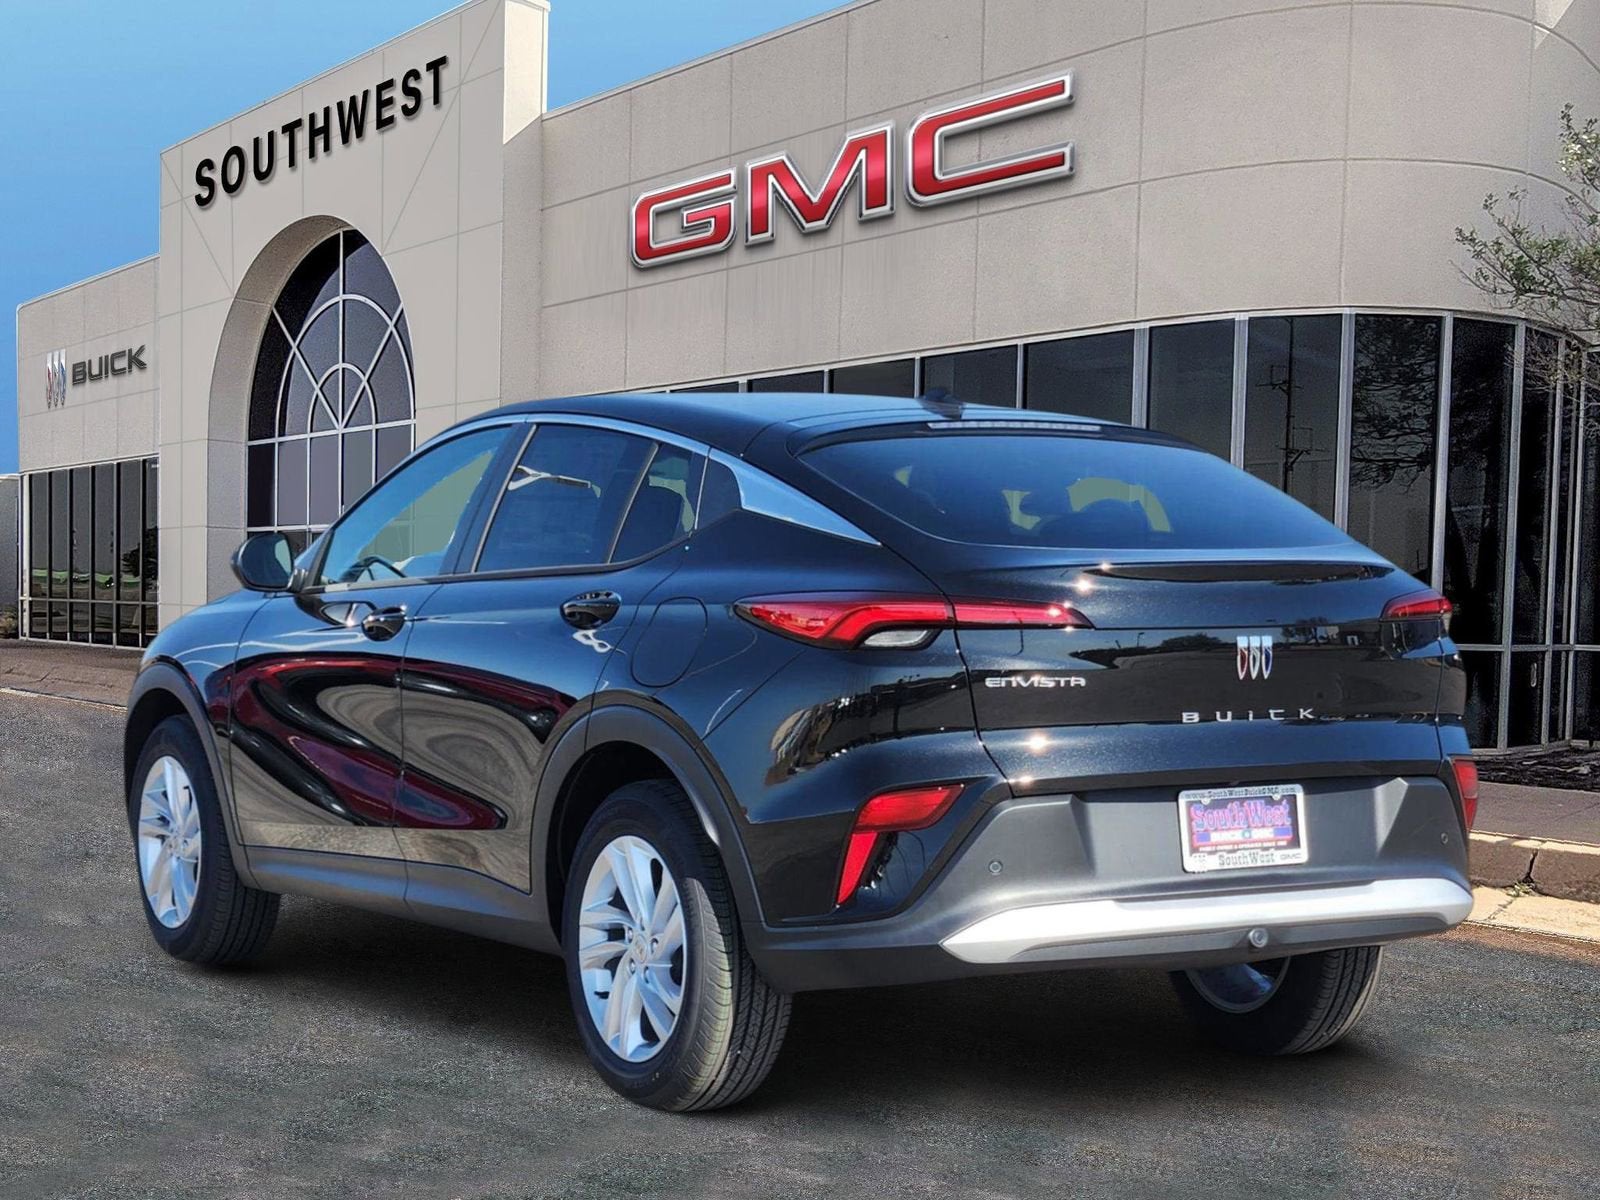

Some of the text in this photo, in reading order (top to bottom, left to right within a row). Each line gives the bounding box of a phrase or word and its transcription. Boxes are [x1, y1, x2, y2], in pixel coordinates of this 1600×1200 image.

[194, 55, 448, 208] SOUTHWEST
[631, 70, 1076, 268] GMC
[71, 344, 147, 386] BUICK
[984, 674, 1087, 688] ENVISTA
[1181, 707, 1315, 724] BUICK
